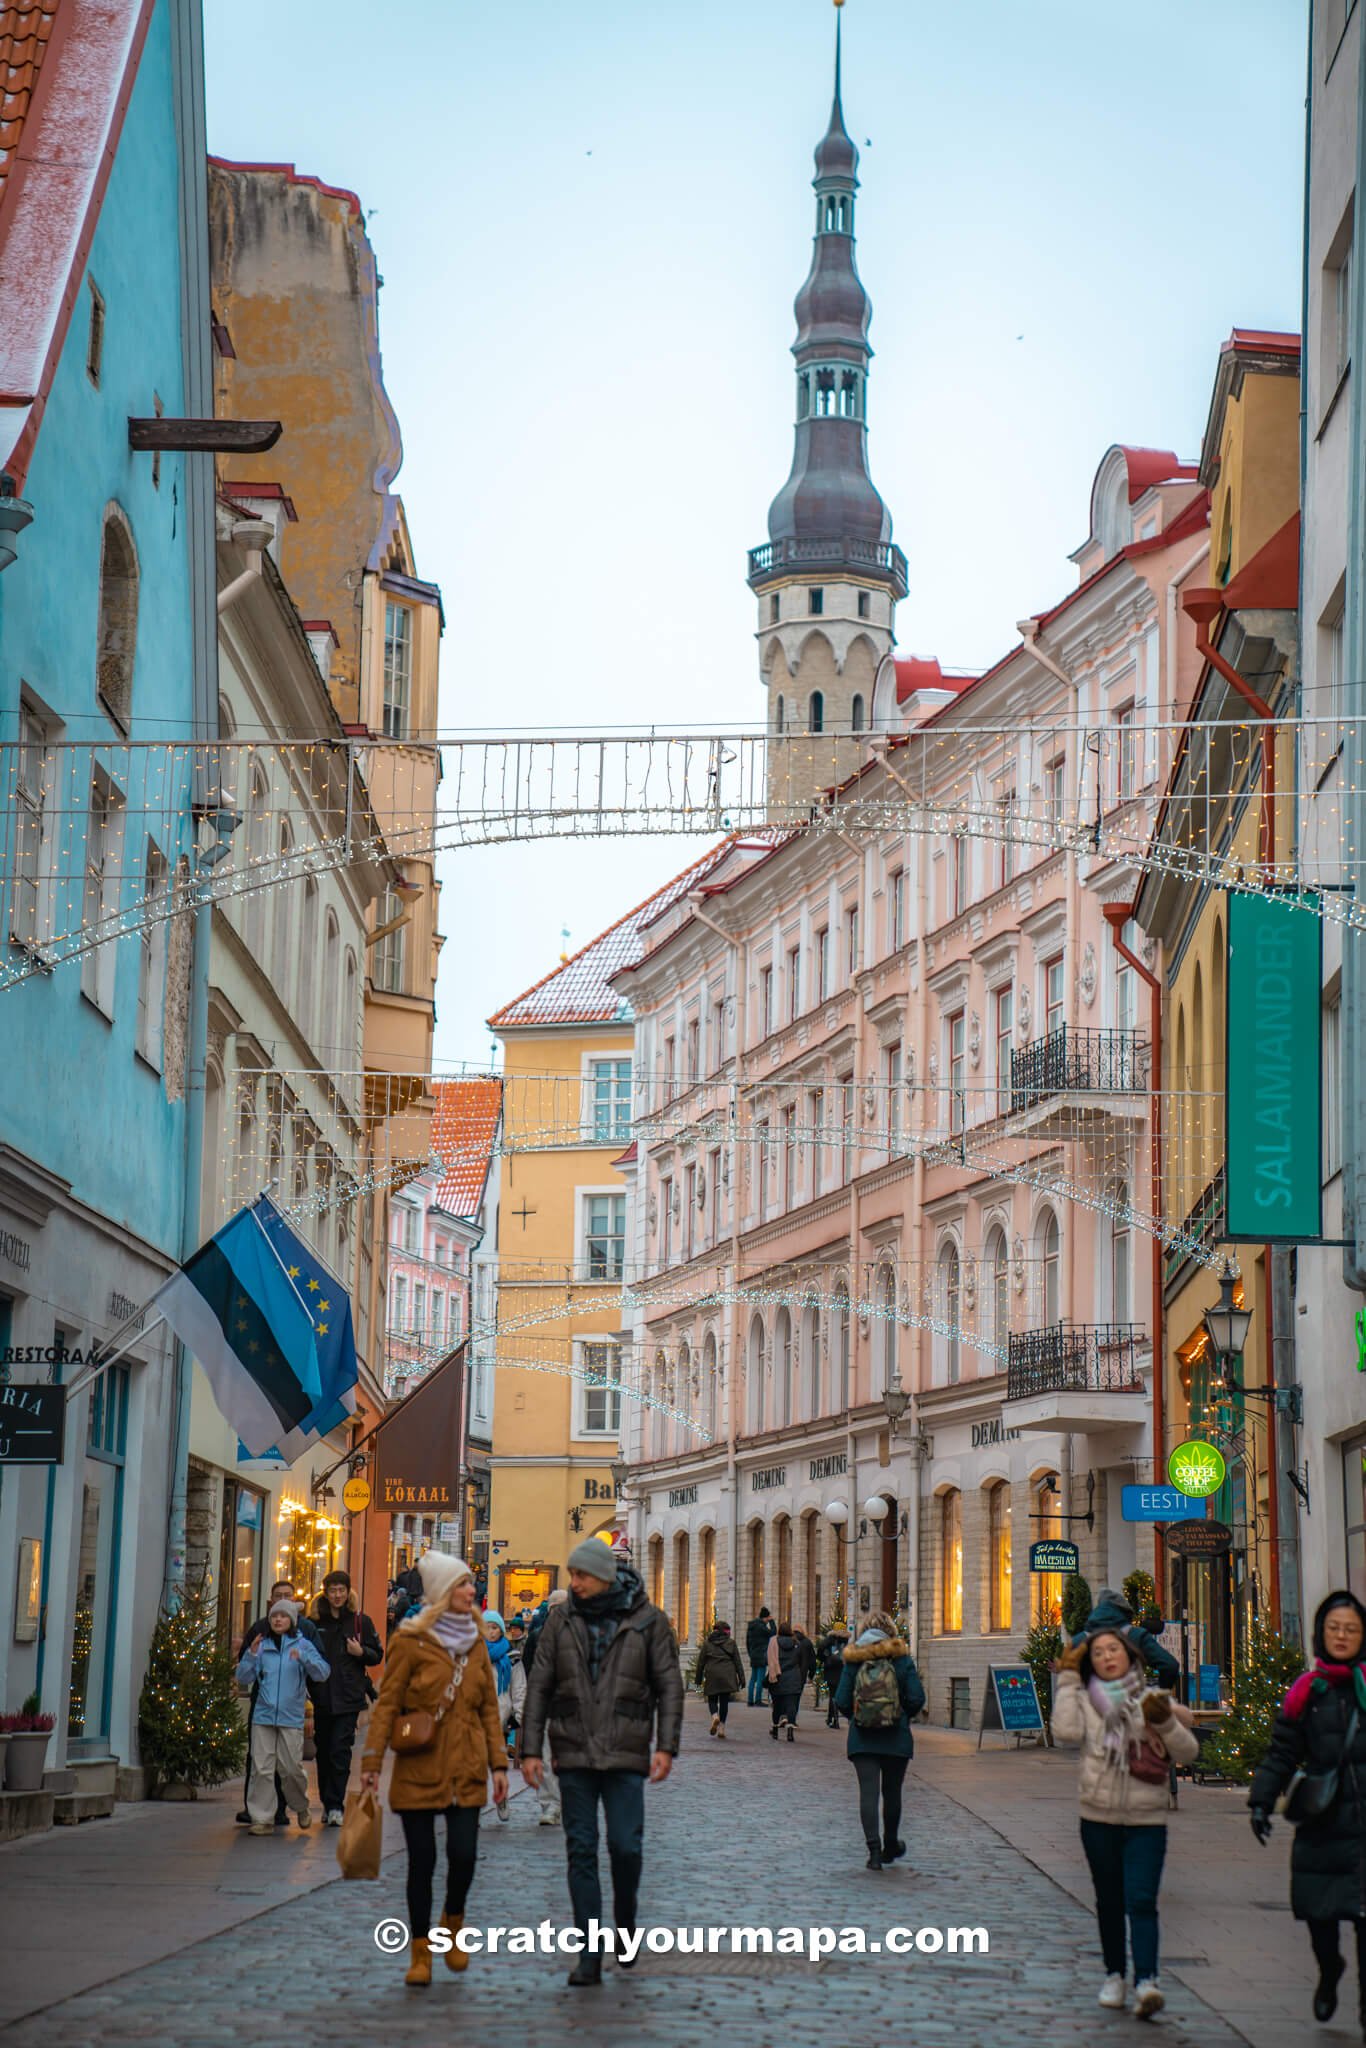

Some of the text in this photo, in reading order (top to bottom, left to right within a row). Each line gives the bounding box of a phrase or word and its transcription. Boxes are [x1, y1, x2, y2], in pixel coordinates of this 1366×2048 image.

[1255, 922, 1293, 1209] SALAMANDER
[1175, 1467, 1217, 1478] COFFEE
[1183, 1477, 1211, 1487] SHOP
[384, 1486, 449, 1502] LOKAAL
[1141, 1493, 1187, 1509] EESTI
